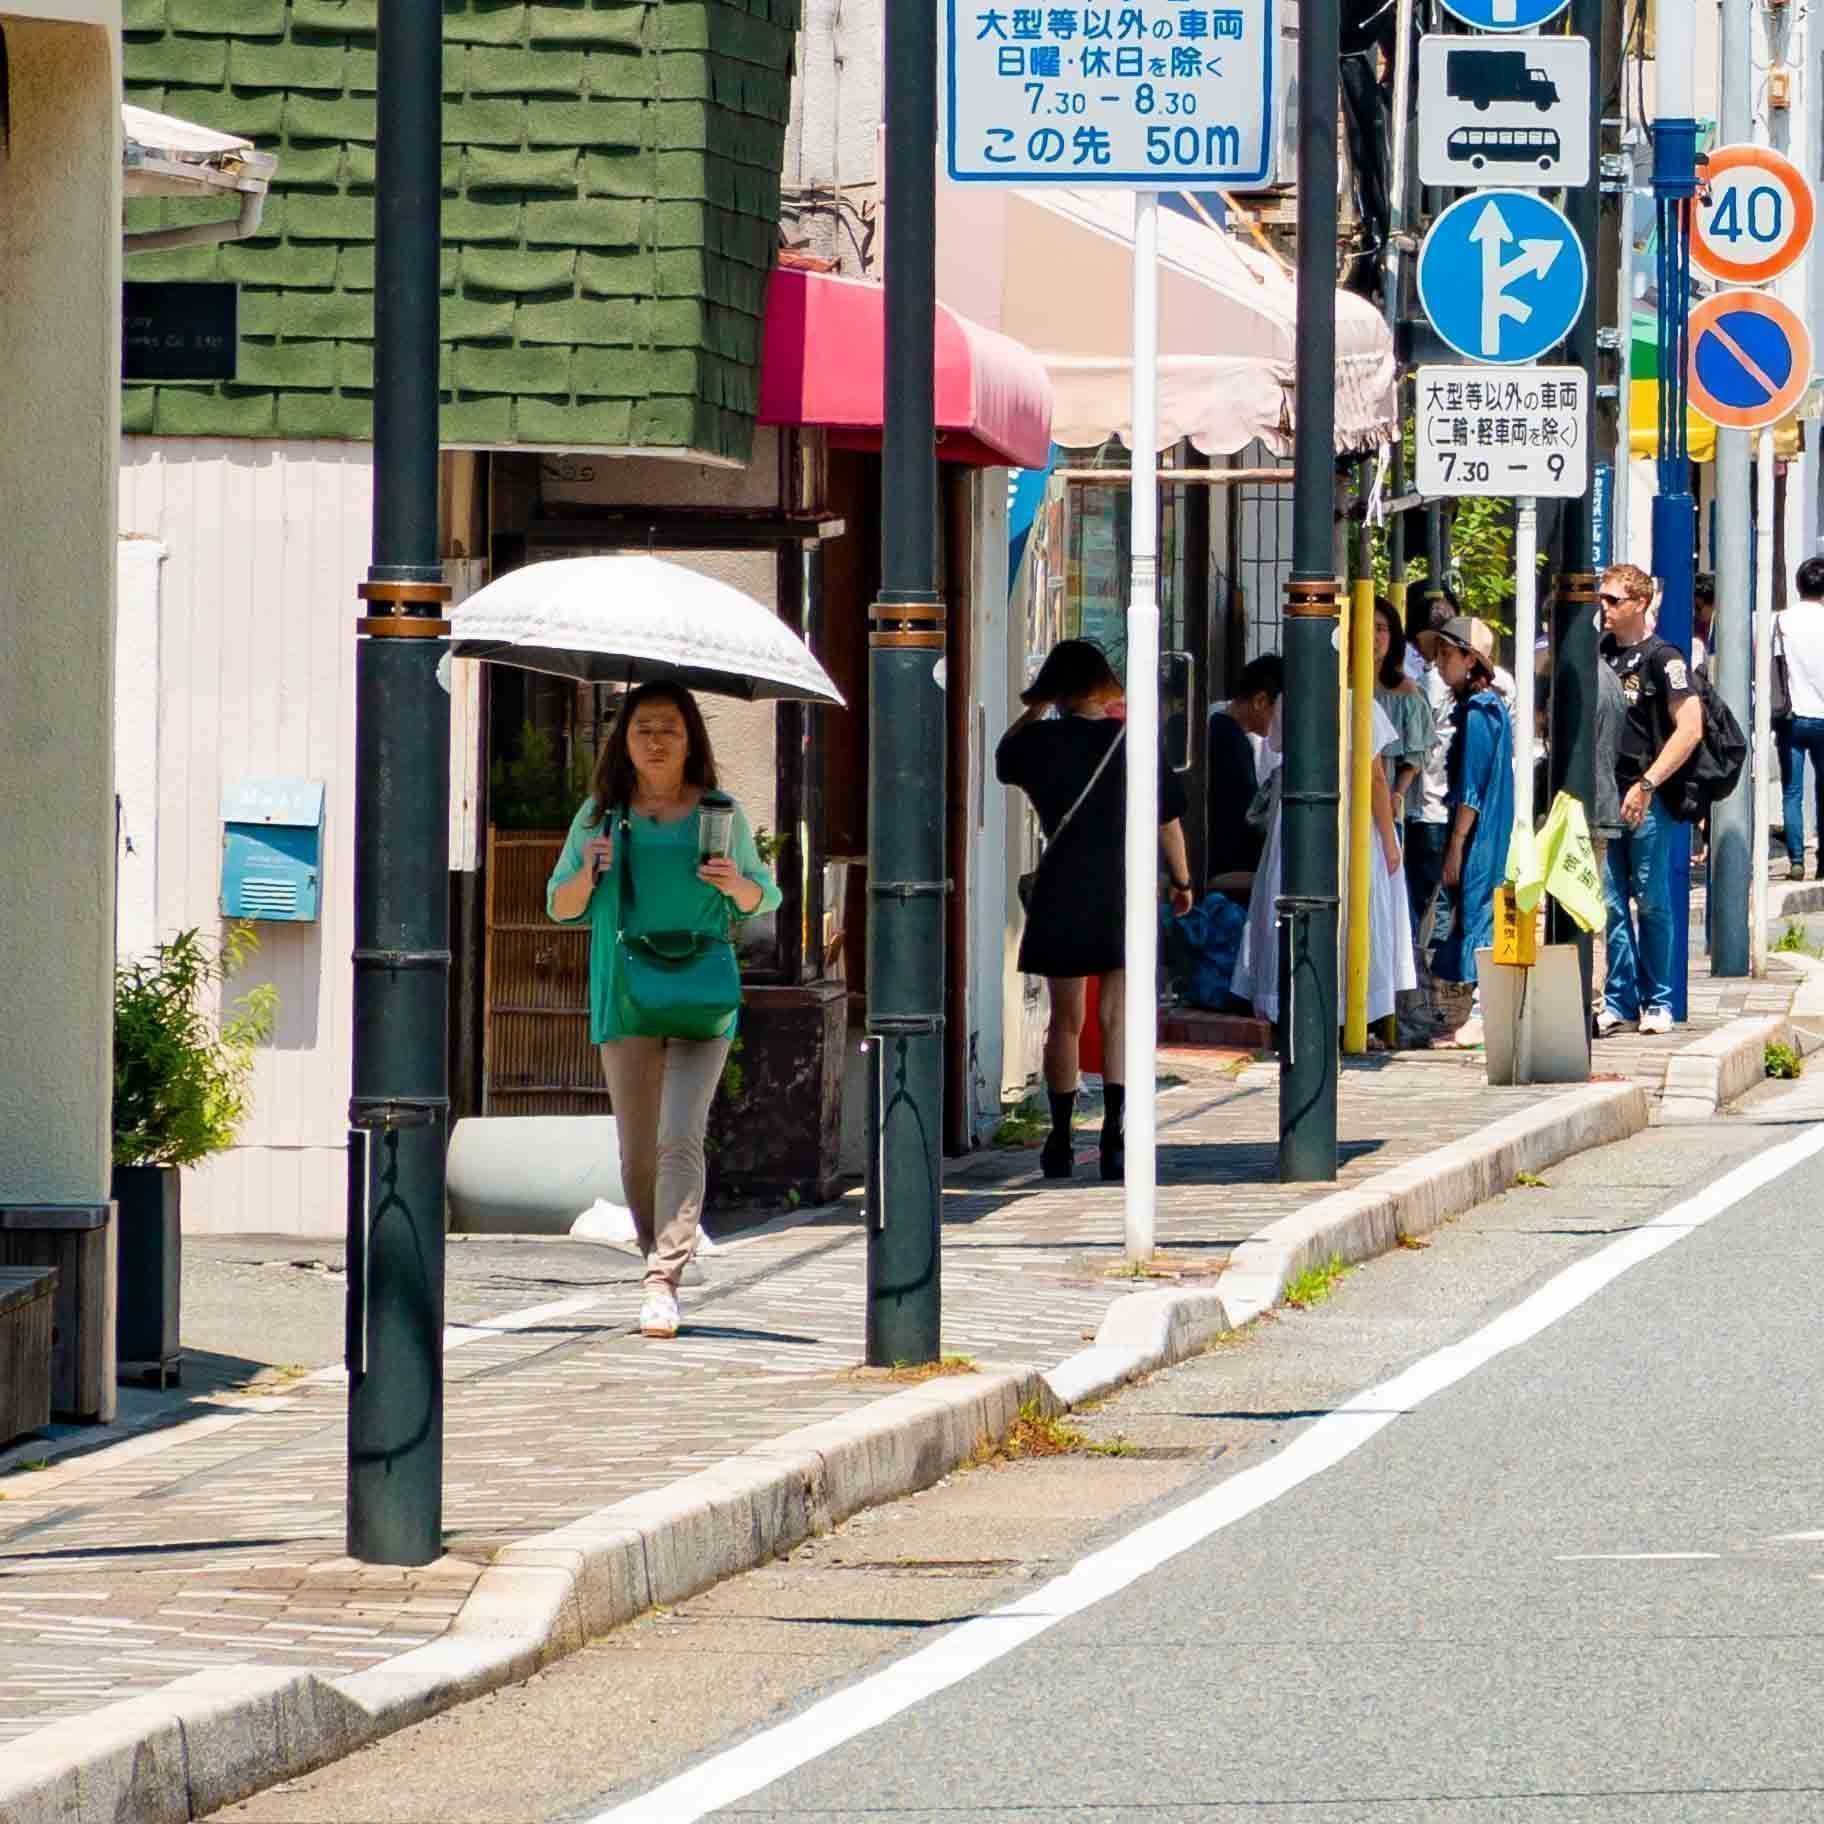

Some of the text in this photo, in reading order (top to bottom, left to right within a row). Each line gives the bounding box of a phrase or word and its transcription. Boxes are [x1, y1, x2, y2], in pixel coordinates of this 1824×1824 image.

[977, 9, 1244, 41] 大型等以外の車両
[998, 45, 1222, 78] 日曜・休日を除く
[1025, 83, 1086, 115] 7.30
[1135, 83, 1196, 115] 8.30
[983, 124, 1240, 166] この先 50m
[1709, 186, 1782, 243] 40
[1425, 382, 1577, 411] 大型等以外の車両
[1427, 416, 1578, 448] (二輪・軽車両を除く)
[1438, 452, 1489, 482] 7.30
[1547, 452, 1566, 482] 9
